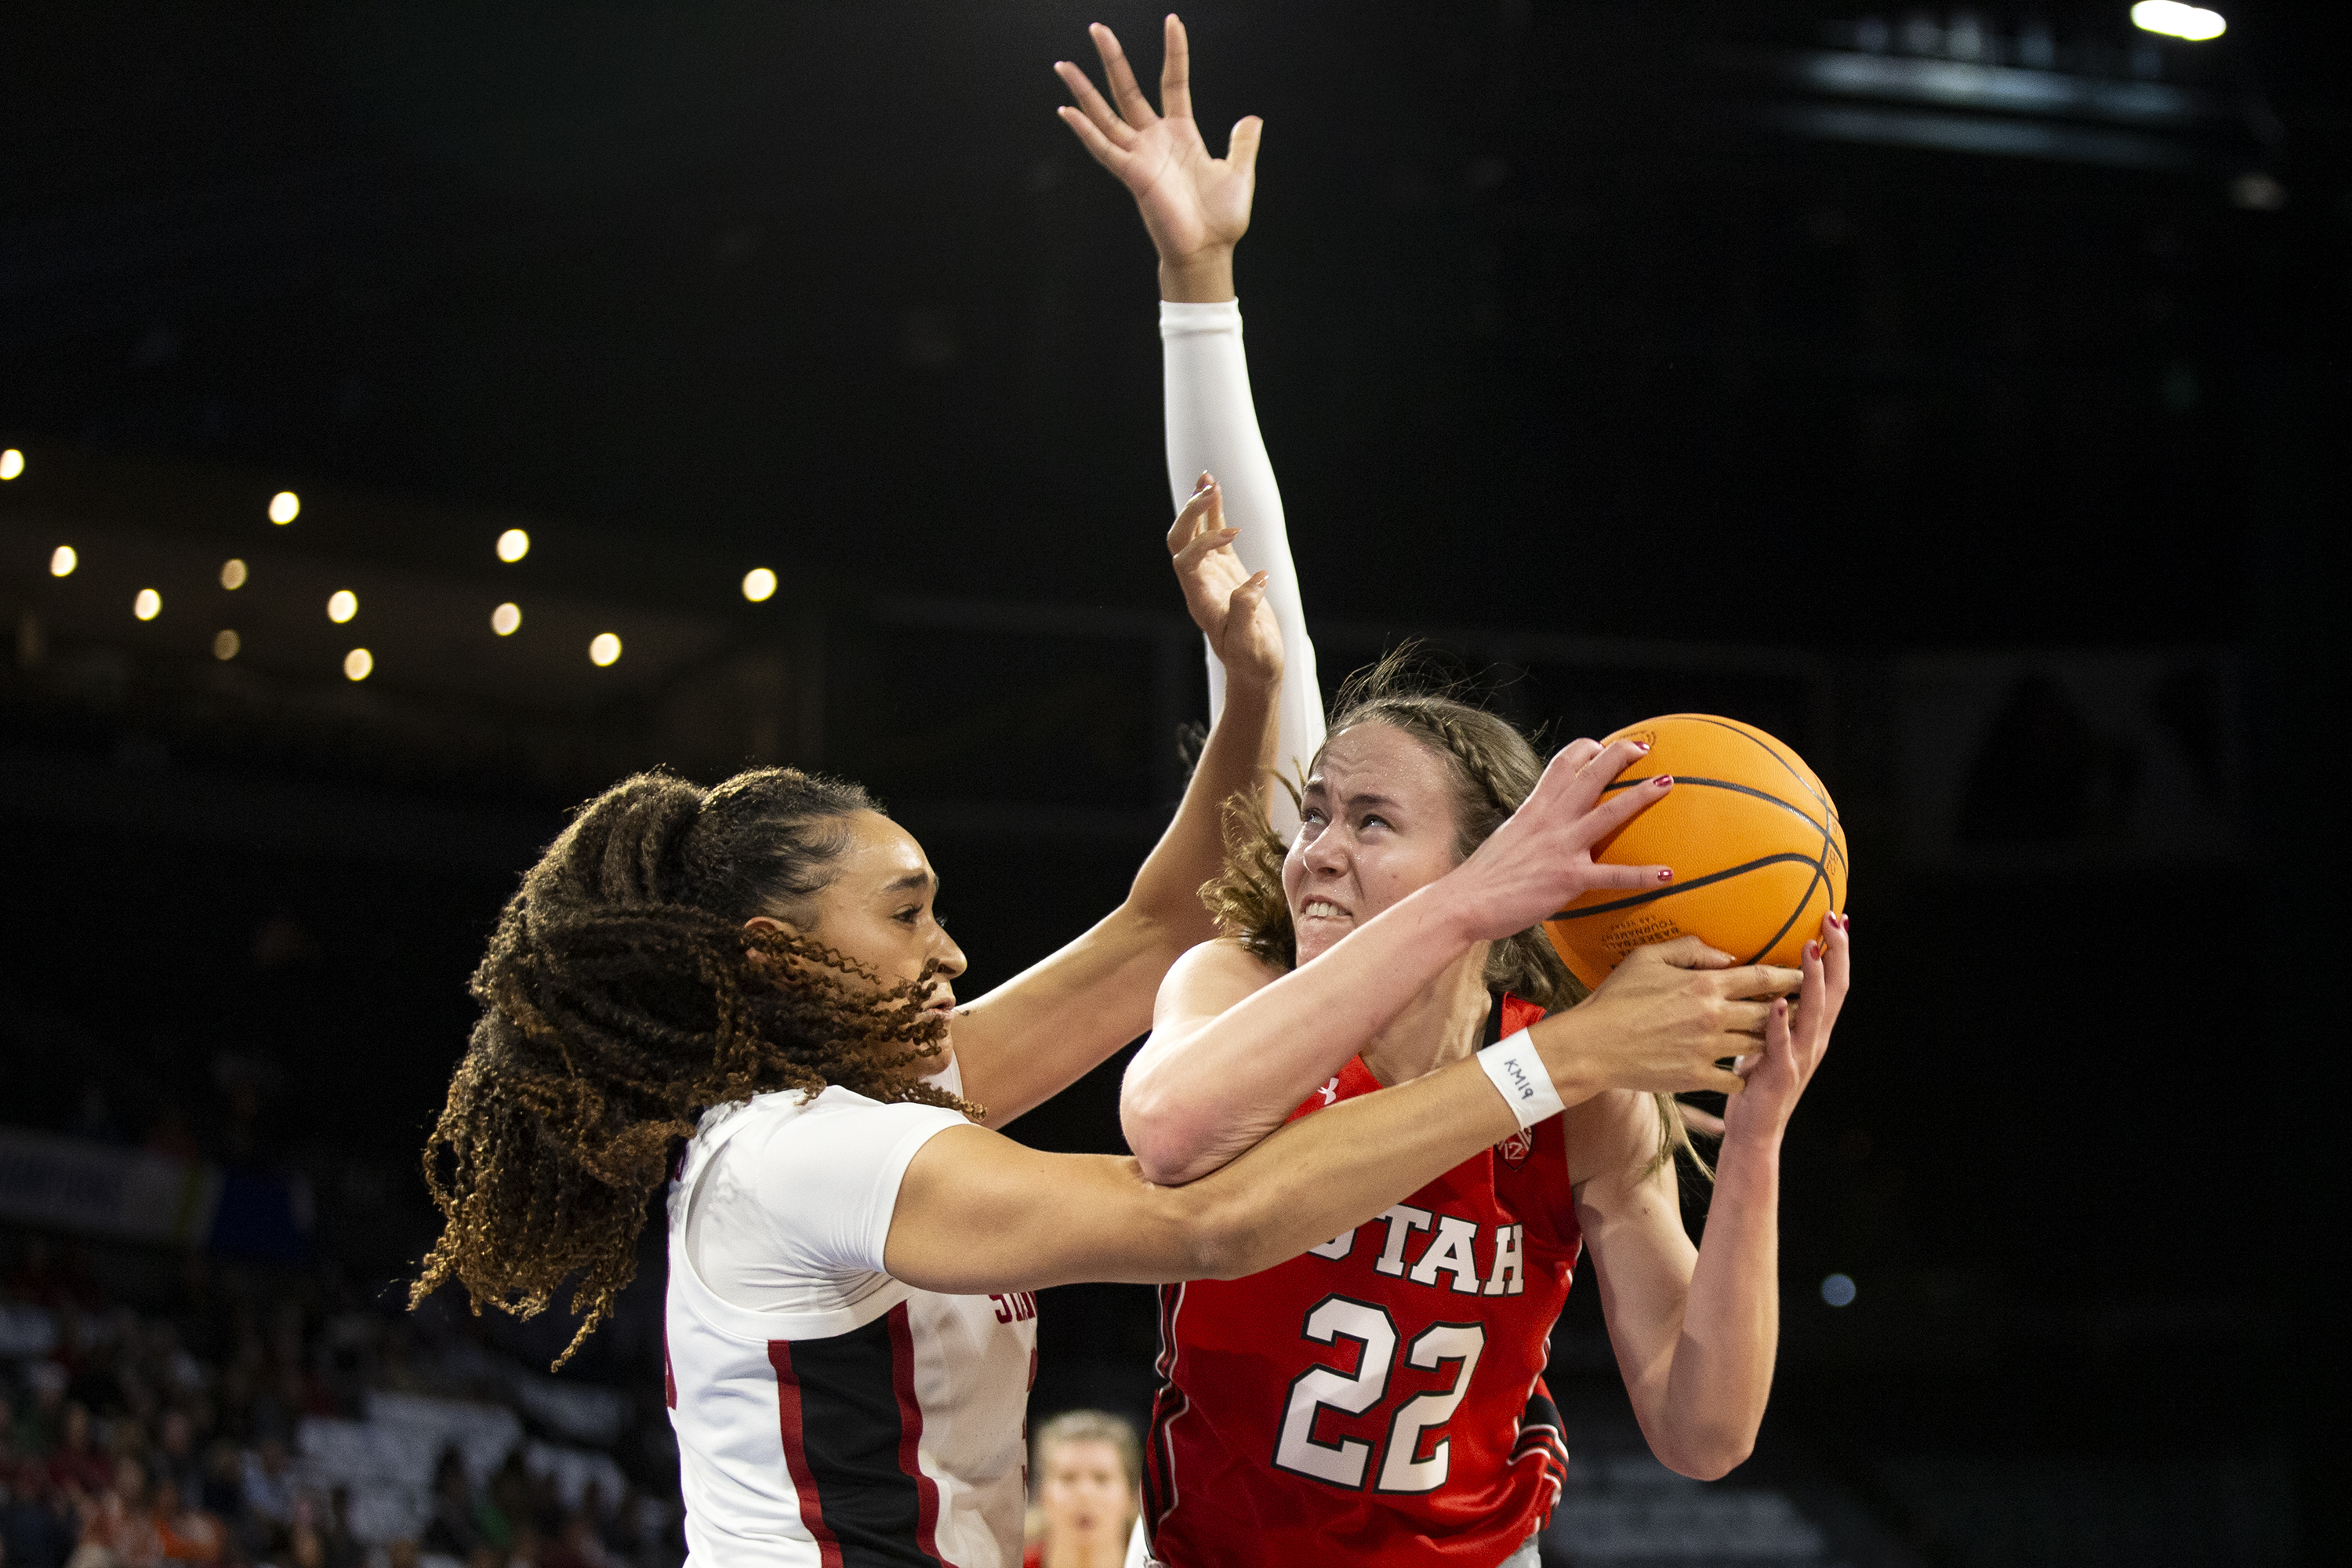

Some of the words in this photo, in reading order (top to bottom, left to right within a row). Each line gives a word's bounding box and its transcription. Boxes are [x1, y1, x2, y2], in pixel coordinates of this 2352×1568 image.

[1601, 919, 1675, 943] TOURNAMENT
[1504, 1058, 1534, 1100] KM19
[1504, 1142, 1523, 1160] 12
[1272, 1294, 1486, 1495] 22
